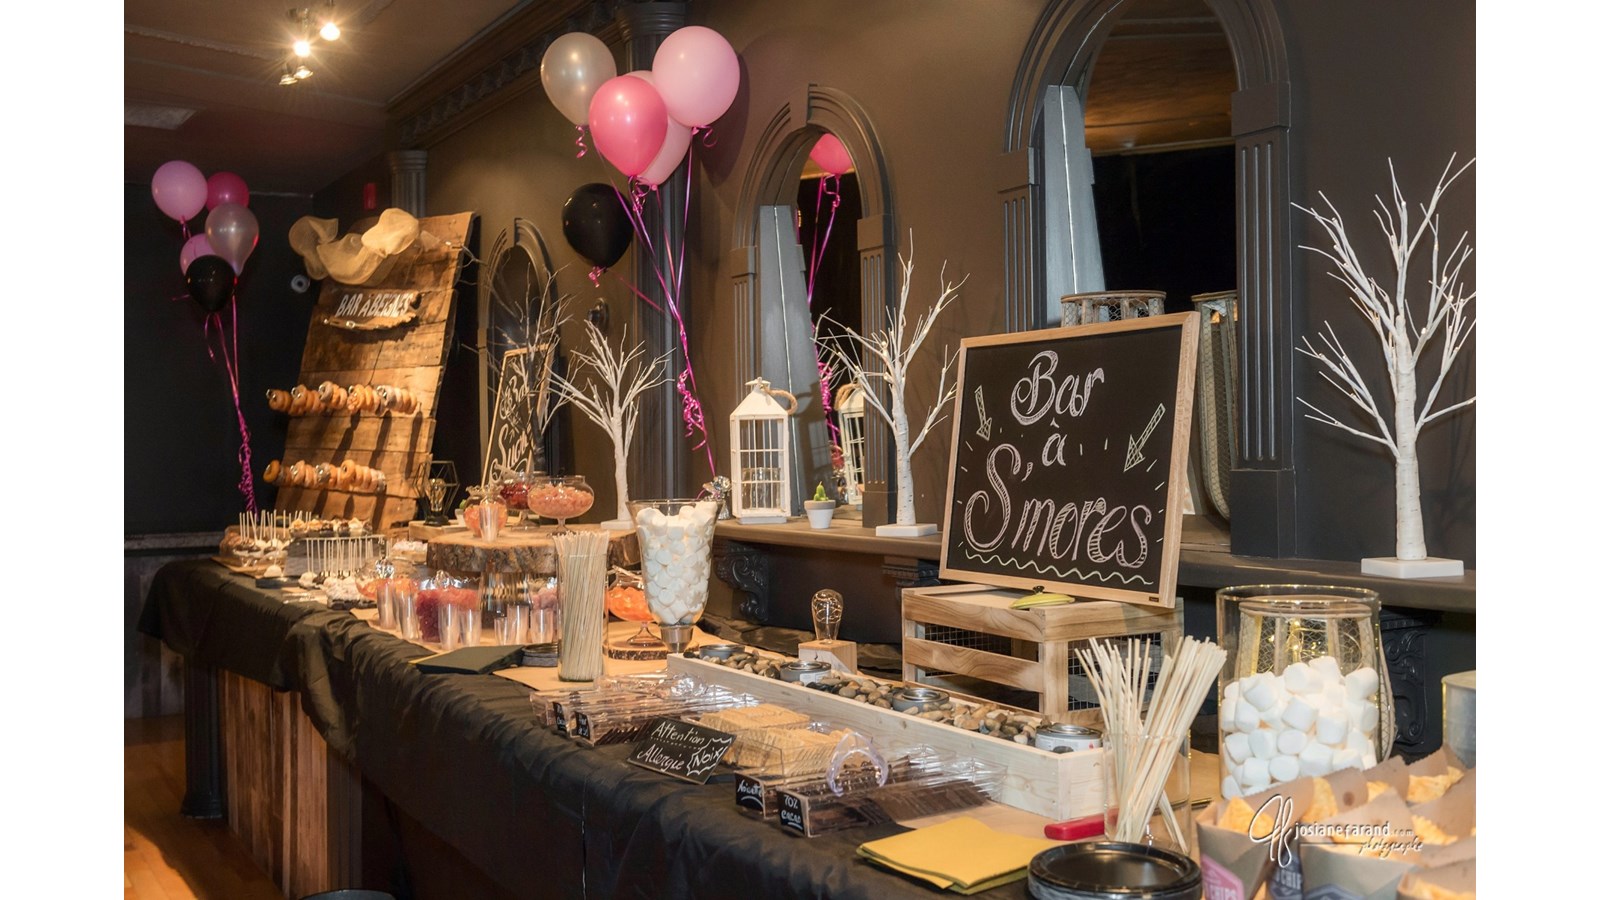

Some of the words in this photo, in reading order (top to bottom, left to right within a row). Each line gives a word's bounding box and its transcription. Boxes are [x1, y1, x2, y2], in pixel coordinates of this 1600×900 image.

[335, 293, 363, 317] BAR
[1011, 350, 1105, 425] Bar
[1042, 417, 1066, 467] à
[651, 721, 705, 744] Attention
[637, 743, 685, 773] Allergie
[692, 747, 726, 768] Noix
[783, 794, 798, 809] 70%
